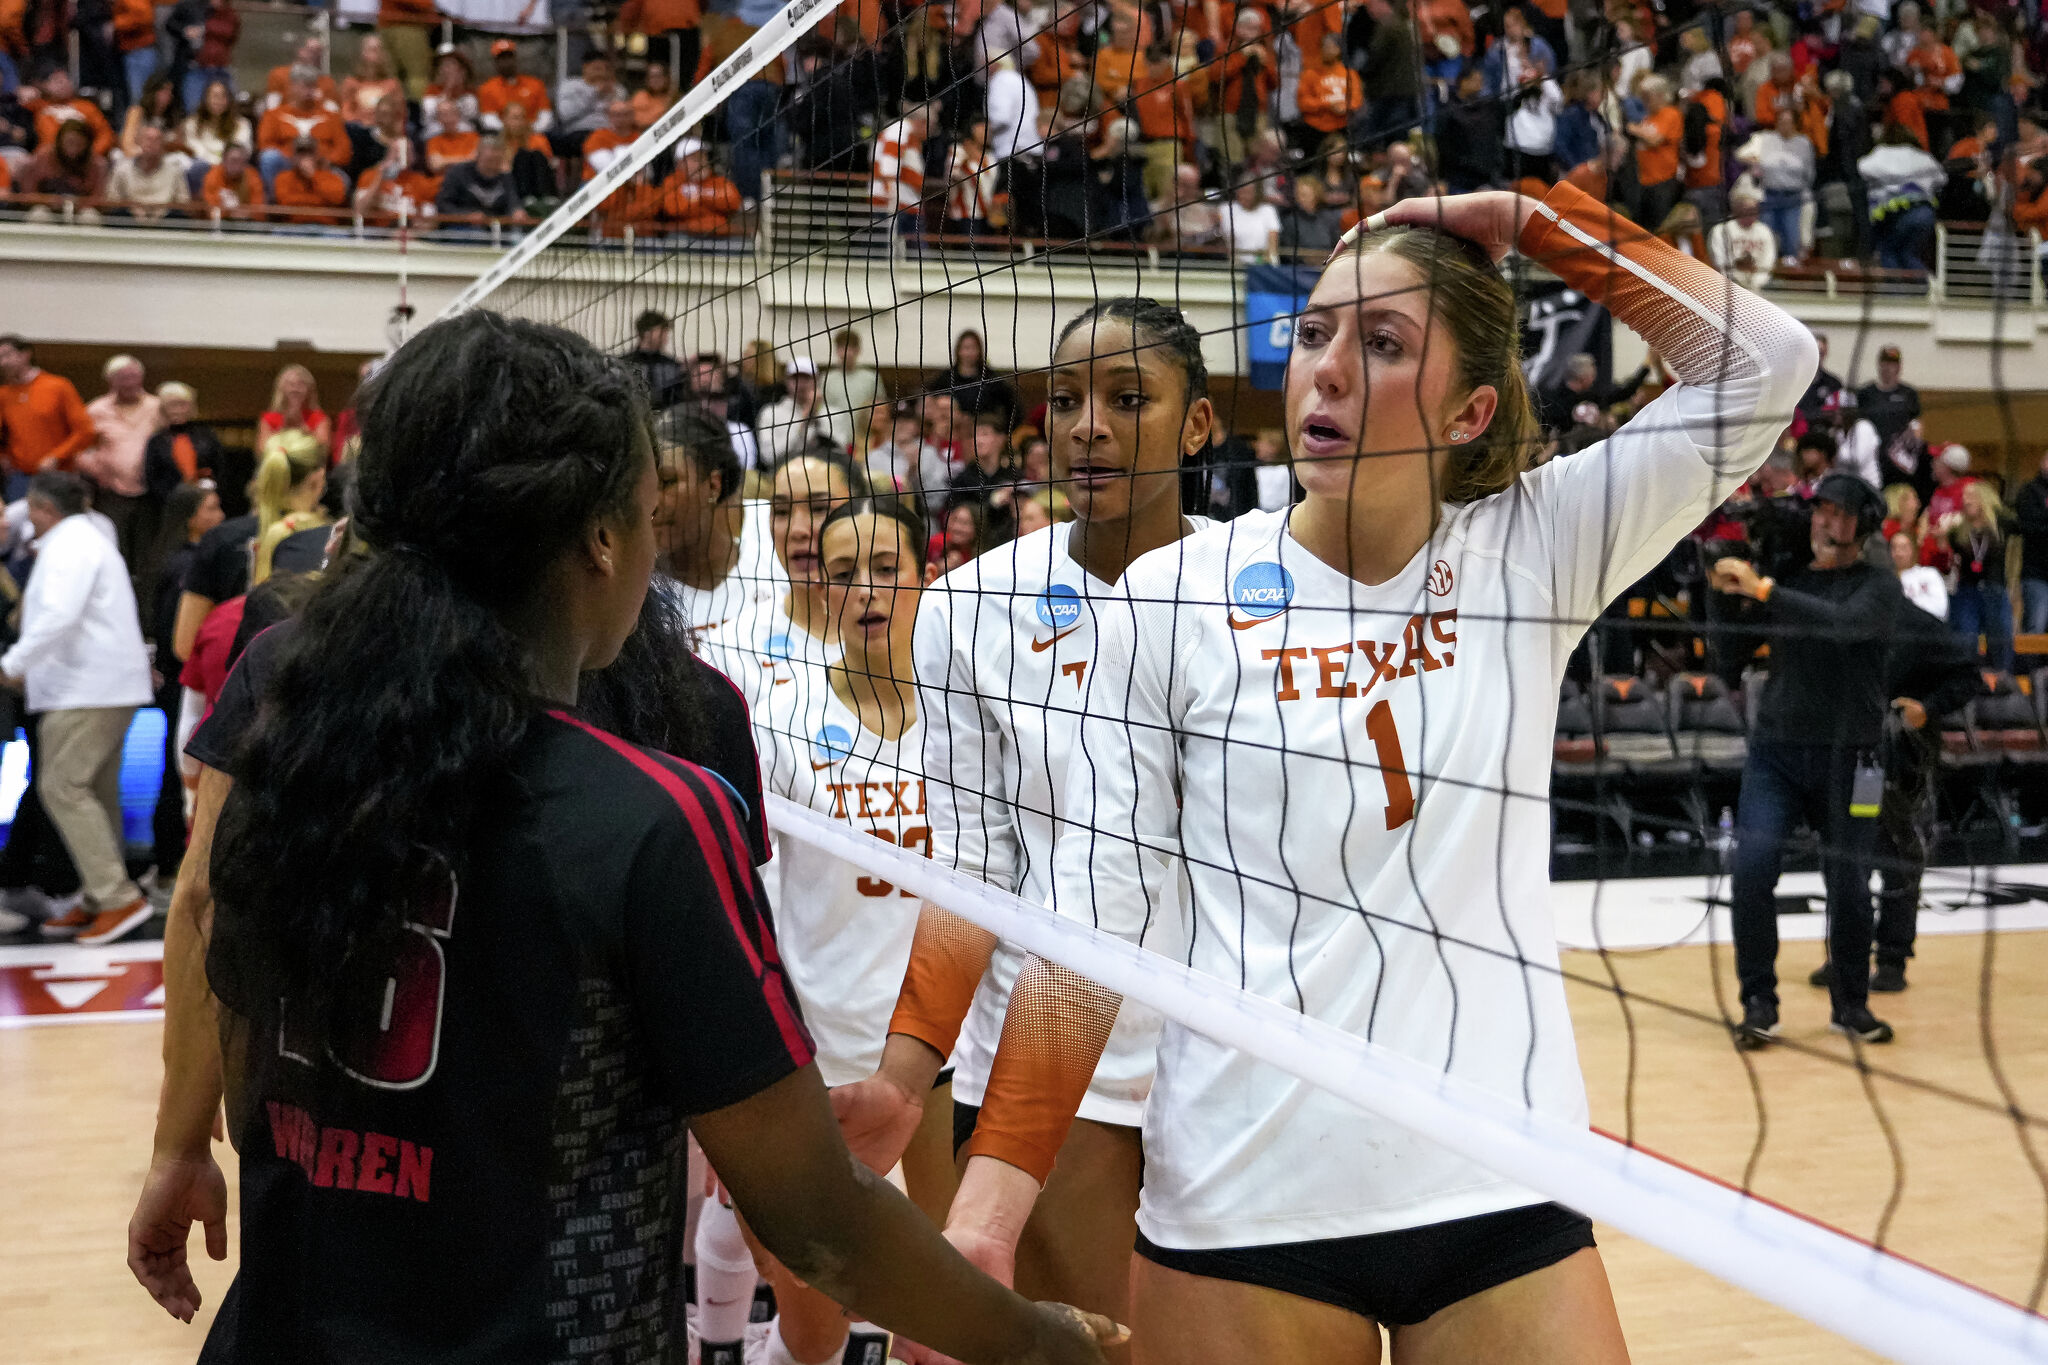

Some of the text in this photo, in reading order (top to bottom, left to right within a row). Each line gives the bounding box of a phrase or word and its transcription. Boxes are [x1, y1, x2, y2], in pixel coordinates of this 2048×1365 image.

[1041, 604, 1078, 616] NCAA
[1240, 587, 1289, 602] NCAA
[1261, 608, 1458, 702] TEXAS
[1366, 700, 1416, 831] 1
[826, 780, 926, 819] TEX
[265, 1099, 434, 1202] WREN
